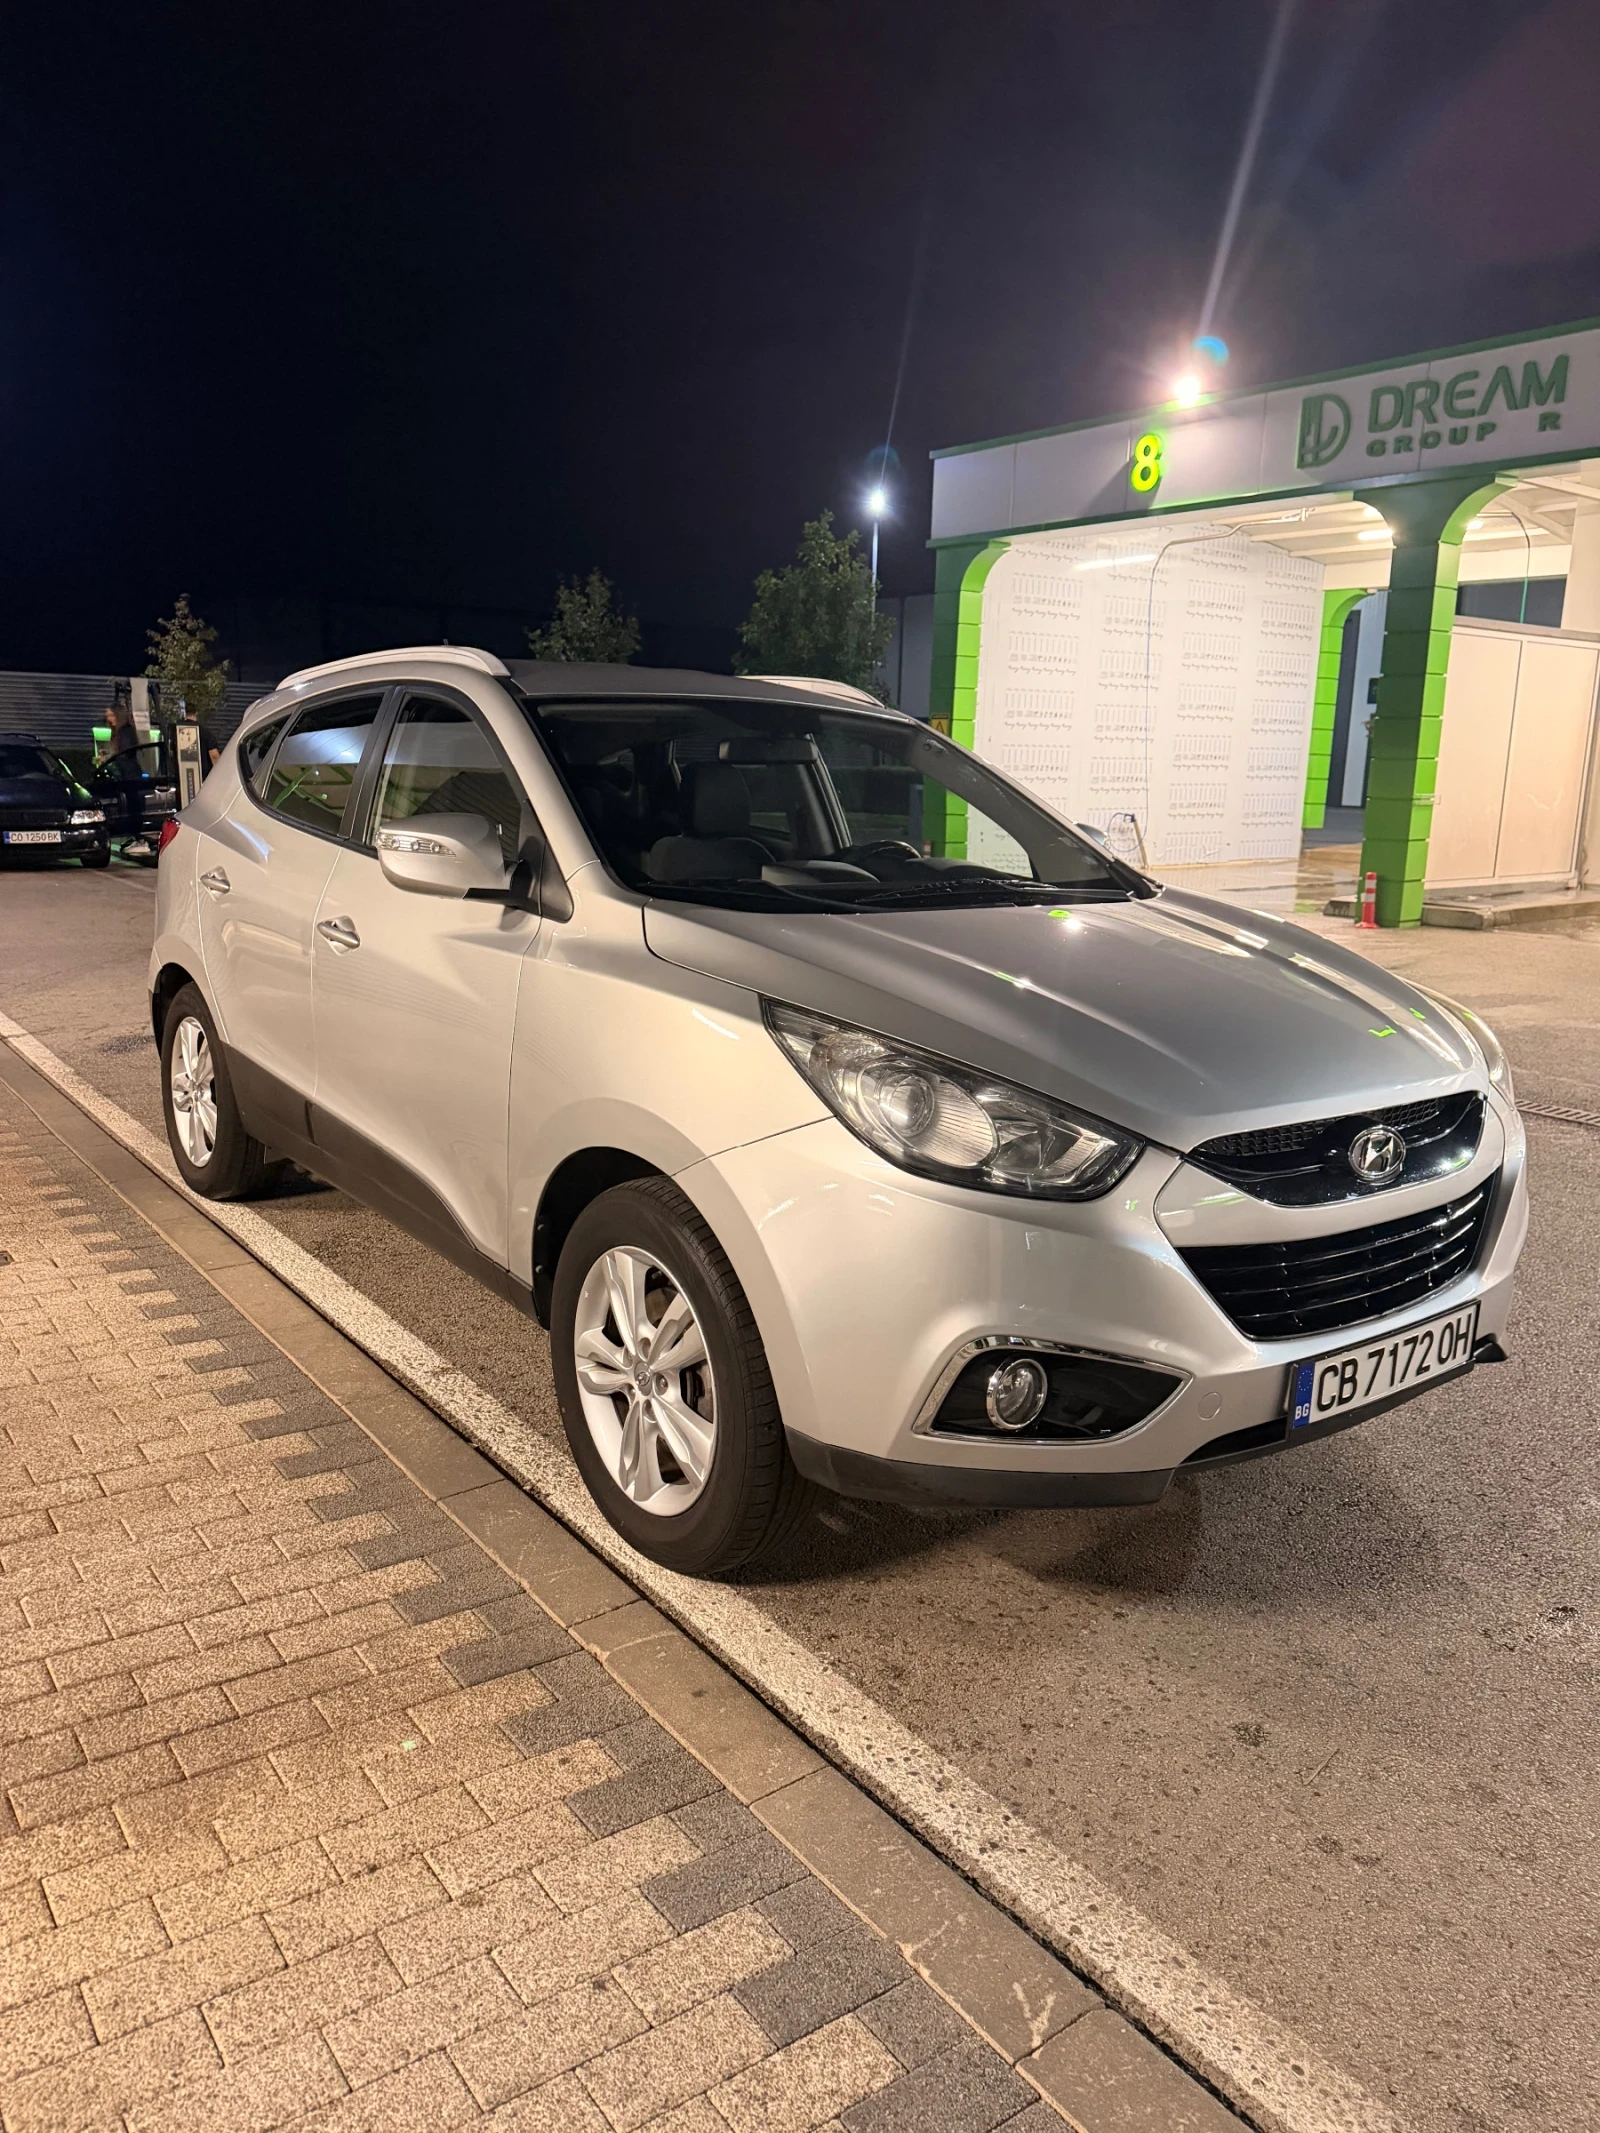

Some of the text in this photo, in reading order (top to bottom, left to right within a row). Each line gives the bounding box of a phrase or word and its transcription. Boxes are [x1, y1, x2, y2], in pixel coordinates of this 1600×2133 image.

[1367, 353, 1570, 433] DREAM
[1366, 421, 1497, 457] GROUP
[1131, 434, 1160, 493] 8
[26, 832, 47, 842] 1250
[1317, 1313, 1472, 1412] CB 7172 OH
[1295, 1403, 1310, 1420] BG
